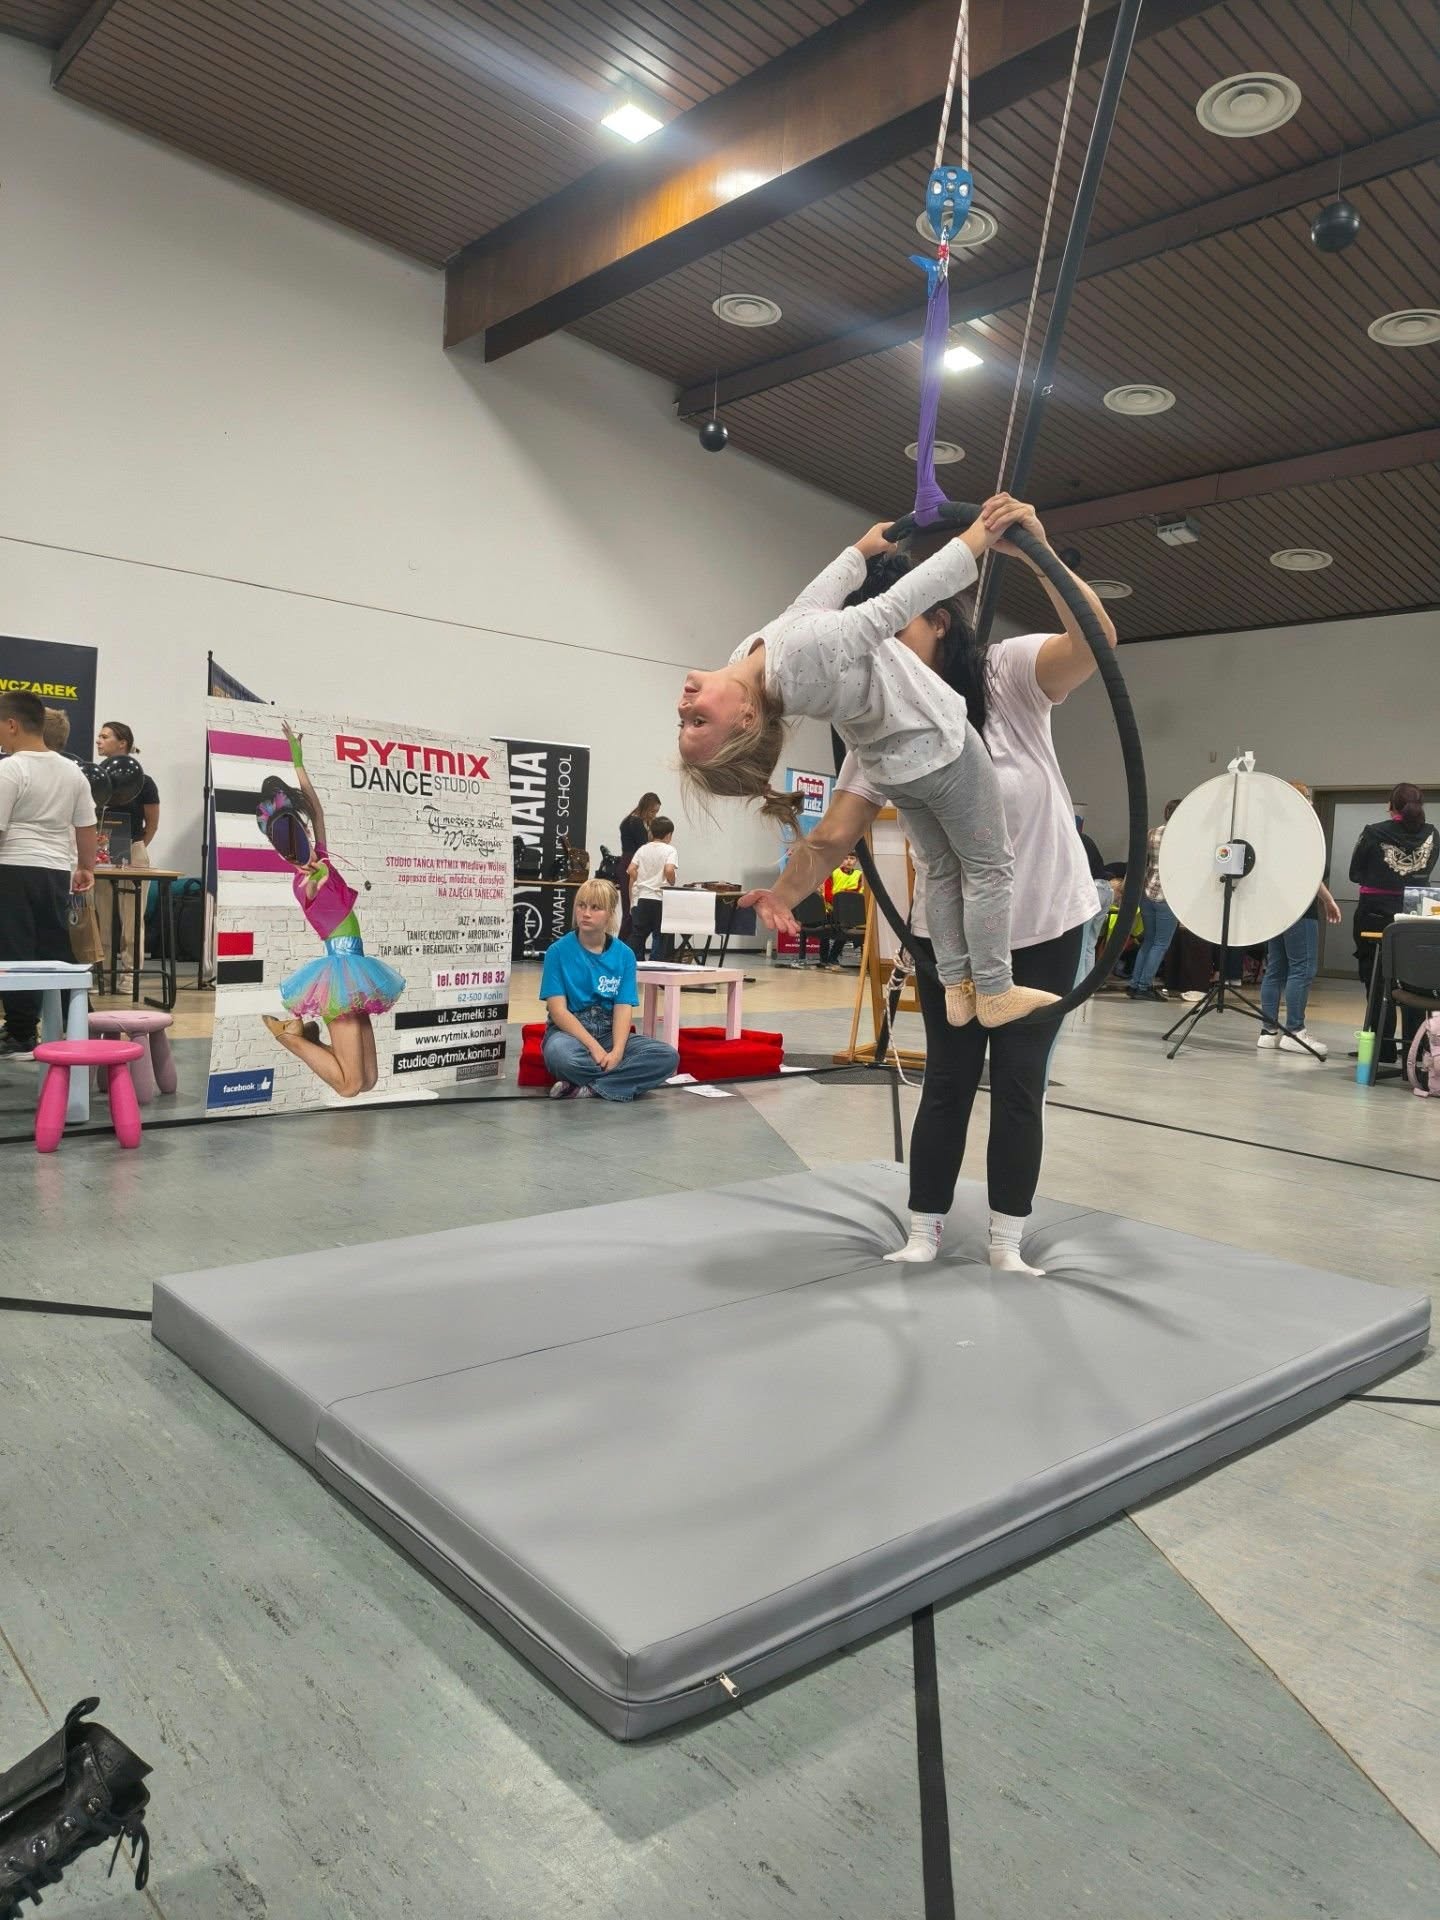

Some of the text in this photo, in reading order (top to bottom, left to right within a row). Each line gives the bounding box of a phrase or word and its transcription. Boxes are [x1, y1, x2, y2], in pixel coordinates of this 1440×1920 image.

[335, 735, 490, 779] RYTMIX
[350, 764, 480, 796] DANCE STUDIO
[557, 754, 572, 817] SCHOOL
[423, 805, 446, 833] Ty
[385, 856, 411, 868] STUDIO
[414, 856, 435, 869] TAŃCA
[436, 858, 459, 870] RYTMIX
[438, 888, 447, 898] NA
[475, 889, 504, 899] TANECZNE
[458, 916, 501, 926] JAZZ MODERN
[407, 930, 501, 940] TANIEC KLASYCZNY AKROBATYKA
[380, 943, 500, 956] TAP DANCE BREAKDANCE SHOW DANCE
[437, 971, 505, 987] tel. 601 71 88 32
[457, 991, 503, 1002] 62-500 Konin
[438, 1007, 498, 1023] ul. Zemełki 36
[415, 1026, 502, 1045] www.rytmix.konin.pl
[398, 1045, 501, 1070] studio@rytmix.konin.pl
[223, 1082, 255, 1093] facebook
